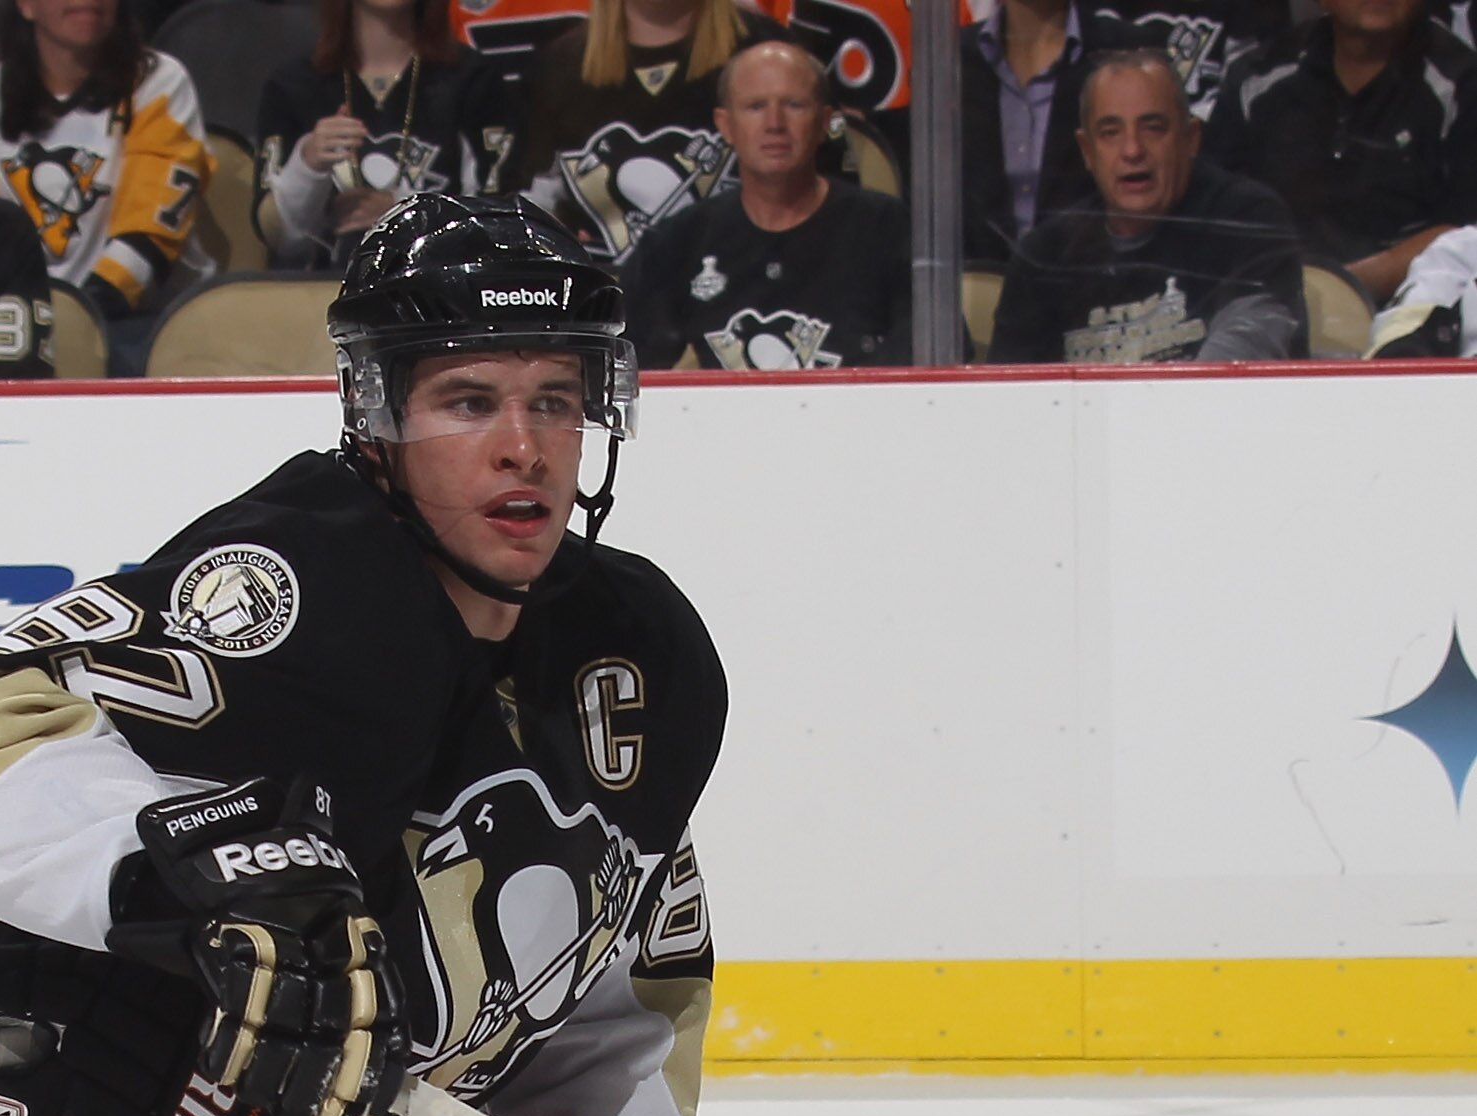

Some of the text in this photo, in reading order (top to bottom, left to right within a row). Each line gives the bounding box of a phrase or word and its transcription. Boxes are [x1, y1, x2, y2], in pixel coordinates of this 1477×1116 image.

[480, 287, 559, 307] Reebok
[211, 552, 287, 588] INAUGURAL
[260, 588, 292, 643] SEASON
[214, 638, 250, 650] 2011
[575, 656, 644, 791] C
[166, 796, 259, 837] PENGUINS
[315, 786, 332, 817] 87
[212, 832, 358, 883] Reeb
